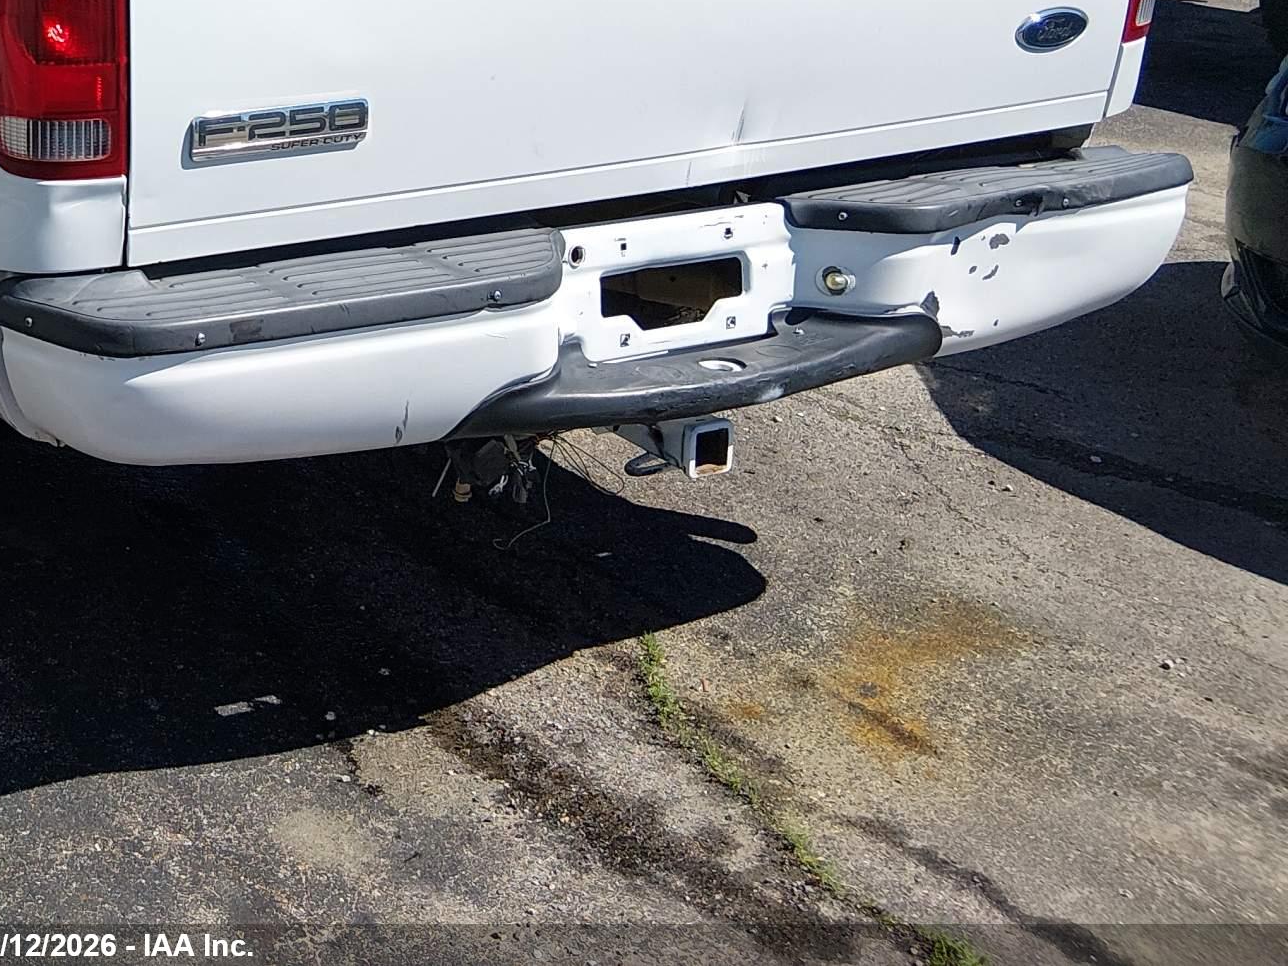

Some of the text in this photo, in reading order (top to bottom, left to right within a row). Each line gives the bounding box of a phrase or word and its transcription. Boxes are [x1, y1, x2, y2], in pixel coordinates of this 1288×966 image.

[197, 101, 369, 147] F-250
[270, 133, 364, 152] SUPER DUTY
